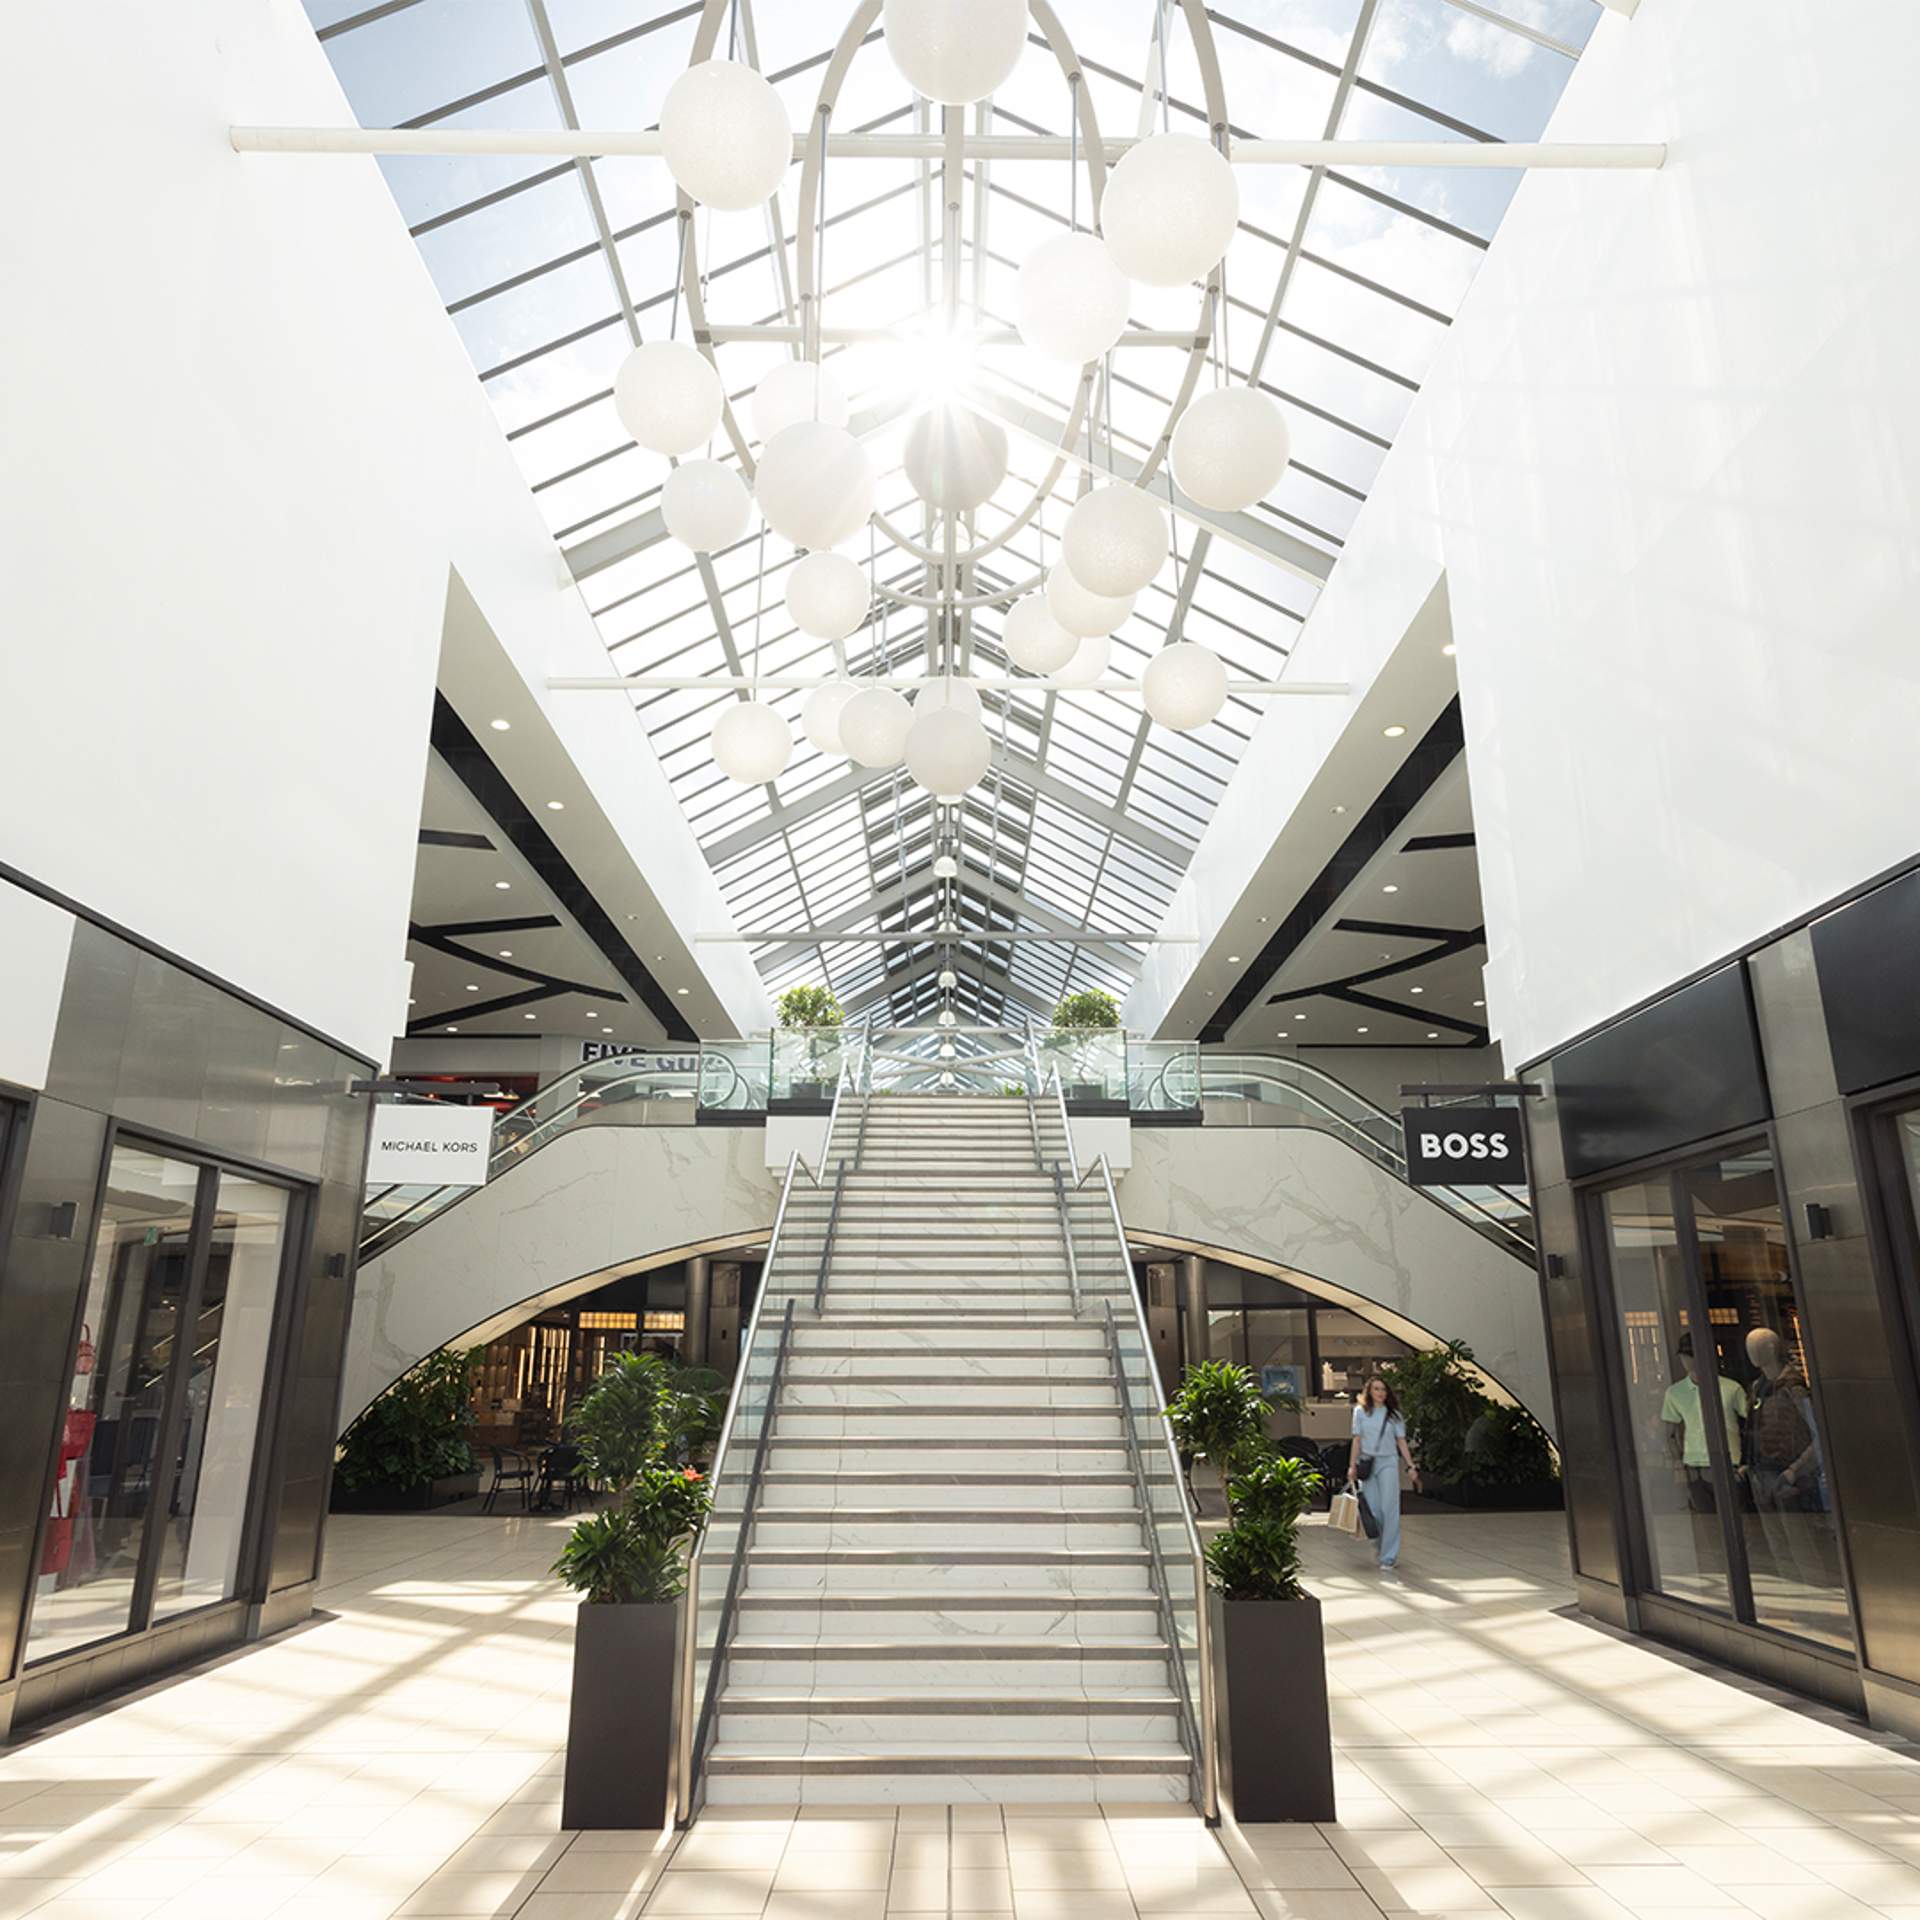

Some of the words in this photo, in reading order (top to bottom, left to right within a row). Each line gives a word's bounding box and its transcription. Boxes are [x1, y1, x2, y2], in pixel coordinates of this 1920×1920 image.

[582, 1042, 647, 1069] FIVE
[381, 1141, 438, 1152] MICHAEL
[442, 1142, 478, 1153] KORS
[1420, 1132, 1509, 1159] BOSS
